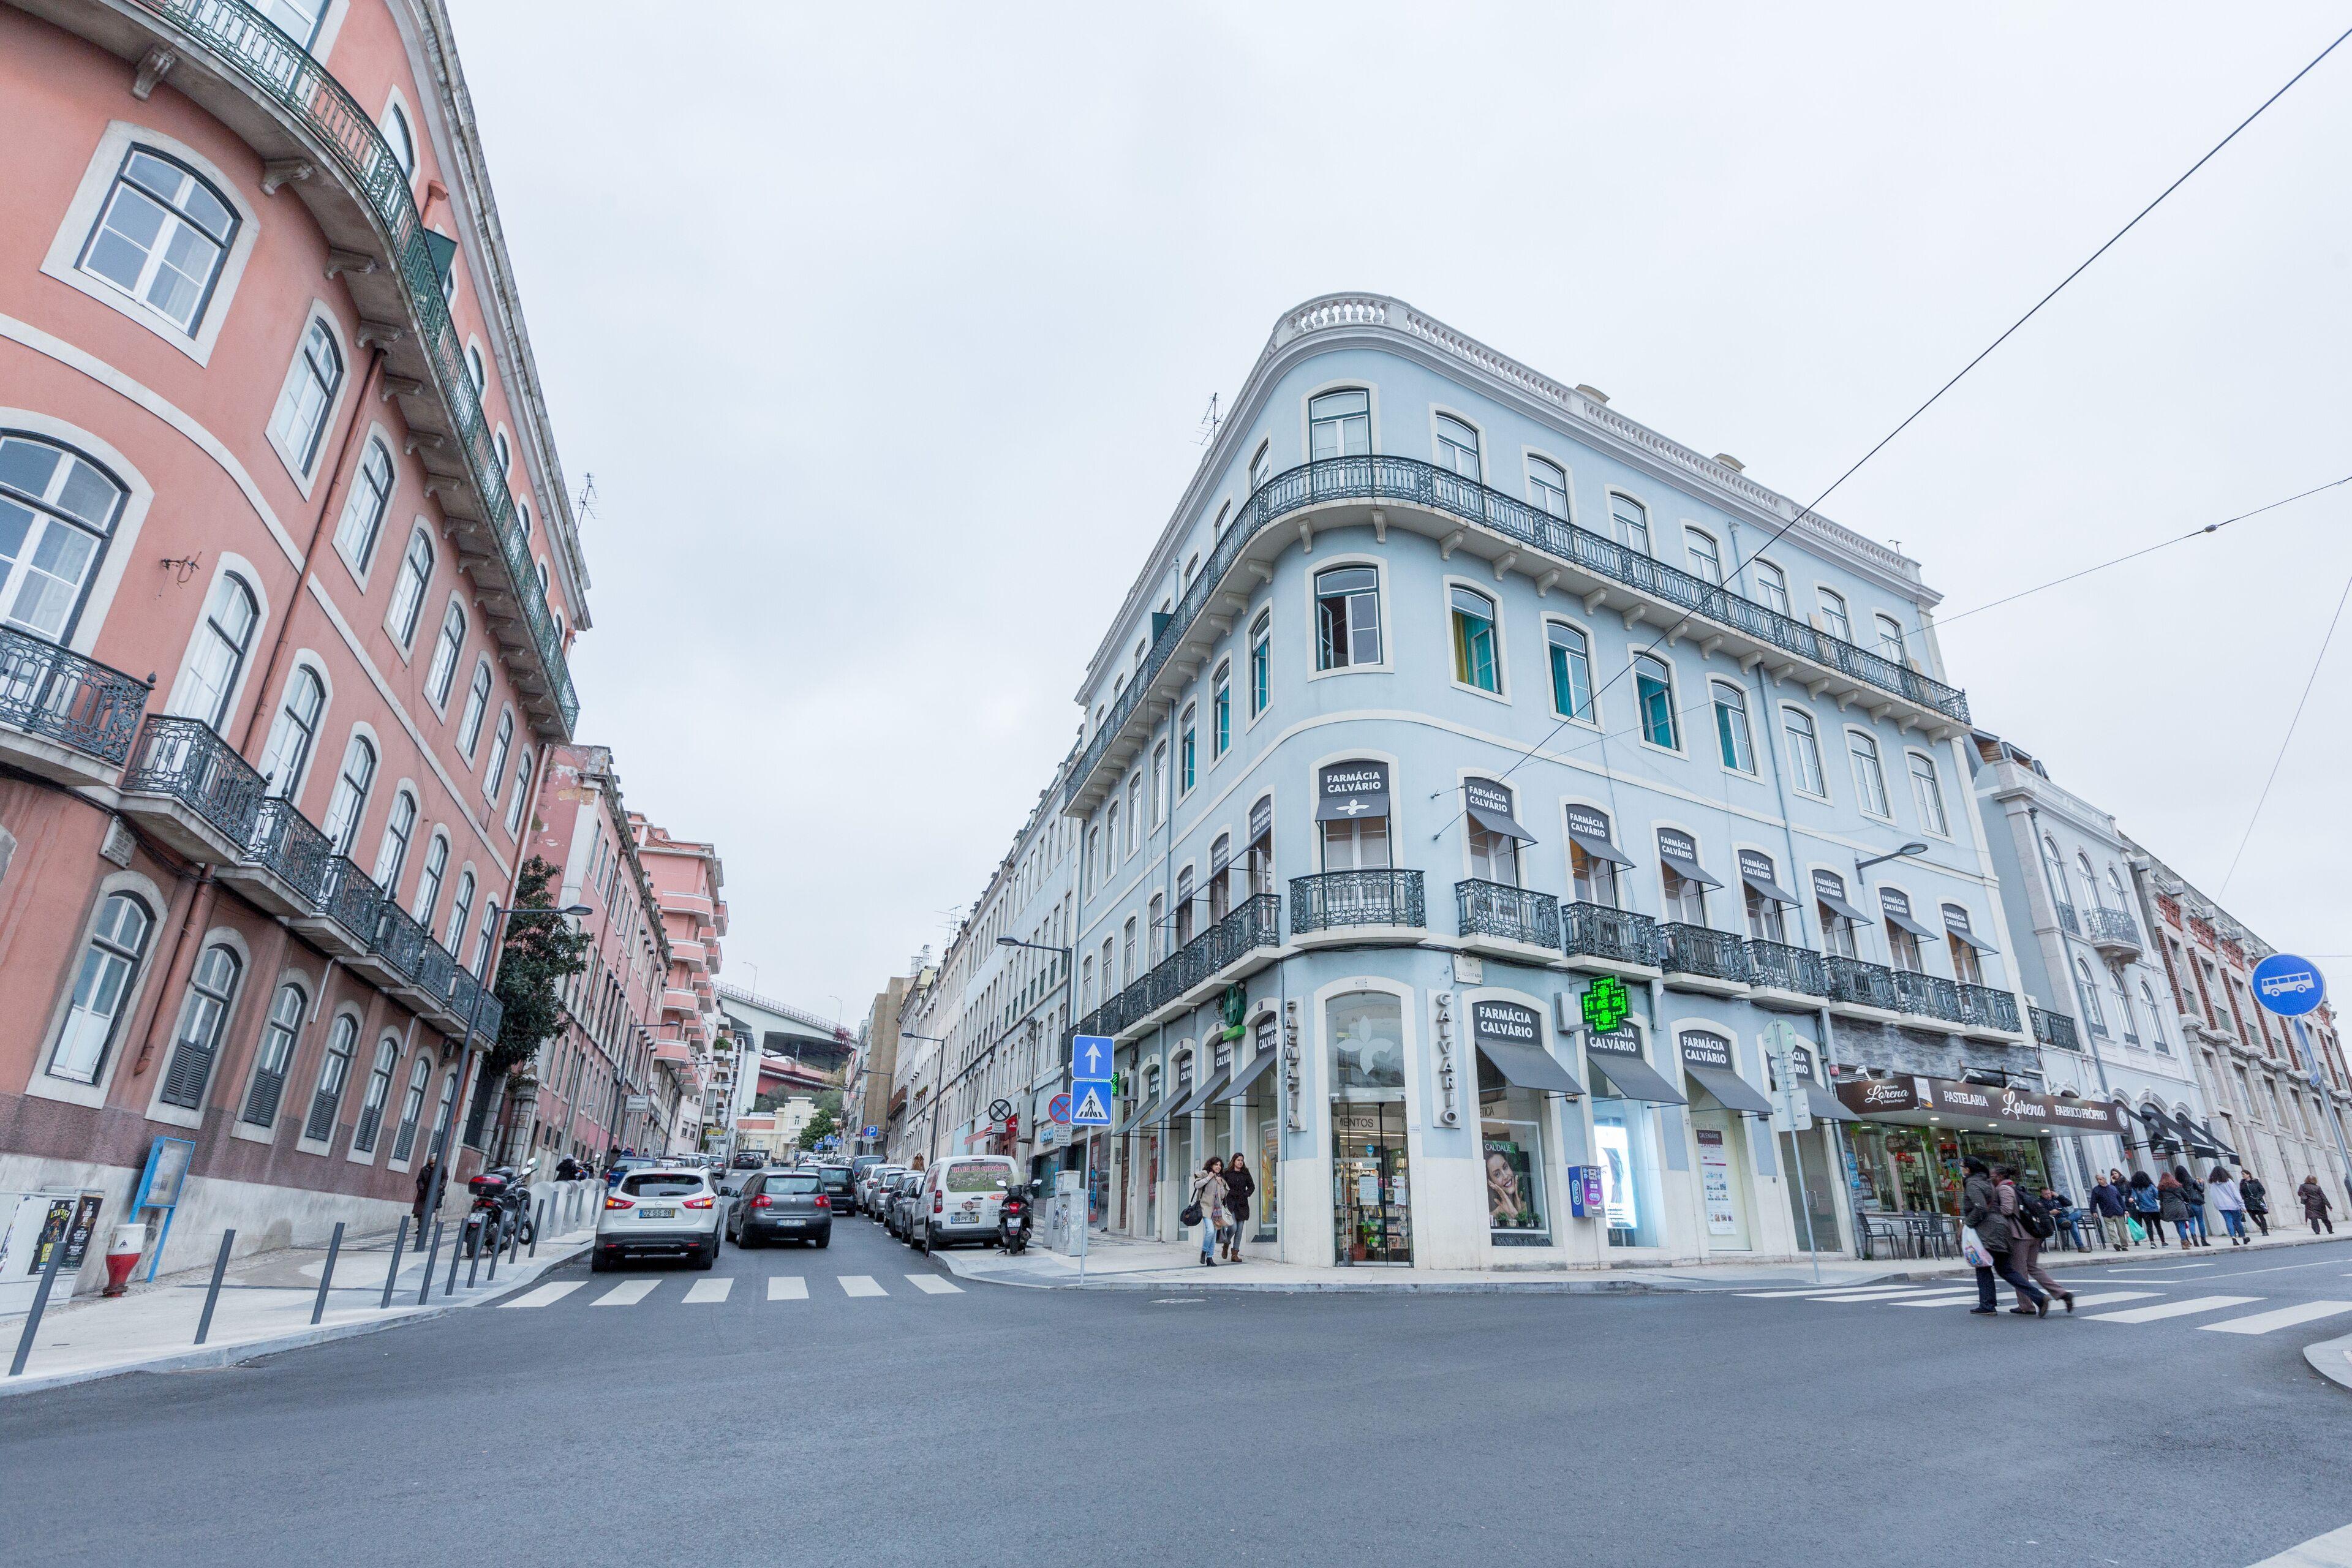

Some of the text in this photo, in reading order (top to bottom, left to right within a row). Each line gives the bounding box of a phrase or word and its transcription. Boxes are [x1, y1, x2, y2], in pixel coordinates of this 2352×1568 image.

[1327, 771, 1381, 783] FARMÁCIA
[1327, 782, 1381, 793] CALVÁRIO
[1469, 786, 1507, 803] FARMÁCIA
[1469, 796, 1508, 813] CALVÁRIO
[1253, 804, 1270, 824] FARMÁCIA
[1569, 813, 1604, 829] FARMÁCIA
[1253, 813, 1271, 834] CALVÁRIO
[1570, 822, 1605, 838] CALVÁRIO
[1660, 836, 1691, 851] FARMÁCIA
[1662, 845, 1693, 859] CALVÁRIO
[1741, 858, 1770, 871] FARMÁCIA
[1743, 866, 1771, 880] CALVÁRIO
[1815, 876, 1841, 889] FARMÁCIA
[1816, 885, 1842, 898] CALVÁRIO
[1882, 895, 1905, 907] FARMÁCIA
[1883, 903, 1907, 914] CALVÁRIO
[1943, 910, 1966, 922] FARMÁCIA
[1945, 918, 1967, 930] CALVÁRIO
[1479, 1006, 1531, 1024] FARMÁCIA
[1480, 1020, 1533, 1039] CALVÁRIO
[1589, 1036, 1636, 1052] CALVÁRIO
[1683, 1036, 1725, 1052] FARMÁCIA
[1436, 993, 1459, 1125] CALVÁRIO
[1685, 1049, 1727, 1064] CALVÁRIO
[1864, 1085, 1909, 1104] Lorena
[1943, 1090, 2108, 1121] PASTELARIA Lorena FABRICO PRÓPRIO
[869, 1127, 875, 1136] P
